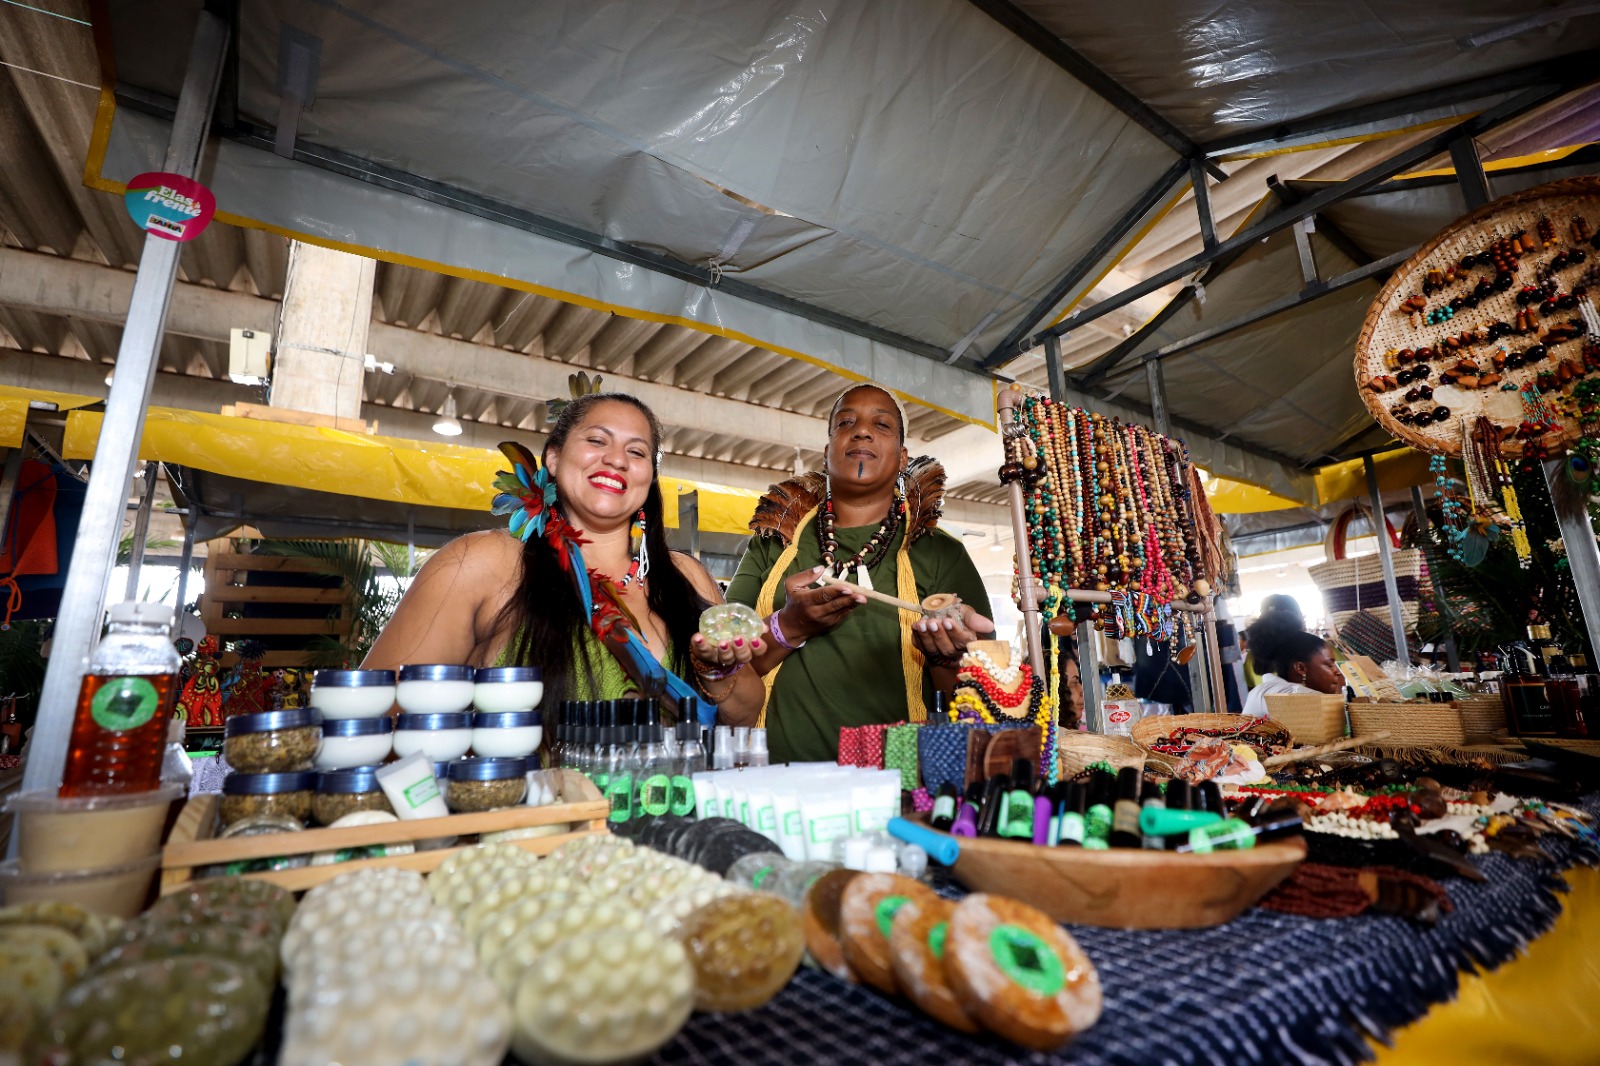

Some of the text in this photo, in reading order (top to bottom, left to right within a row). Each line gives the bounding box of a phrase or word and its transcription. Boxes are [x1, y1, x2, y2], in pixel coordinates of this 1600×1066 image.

[144, 190, 201, 217] frente
[160, 185, 194, 206] Elas
[149, 216, 183, 232] BAHIA
